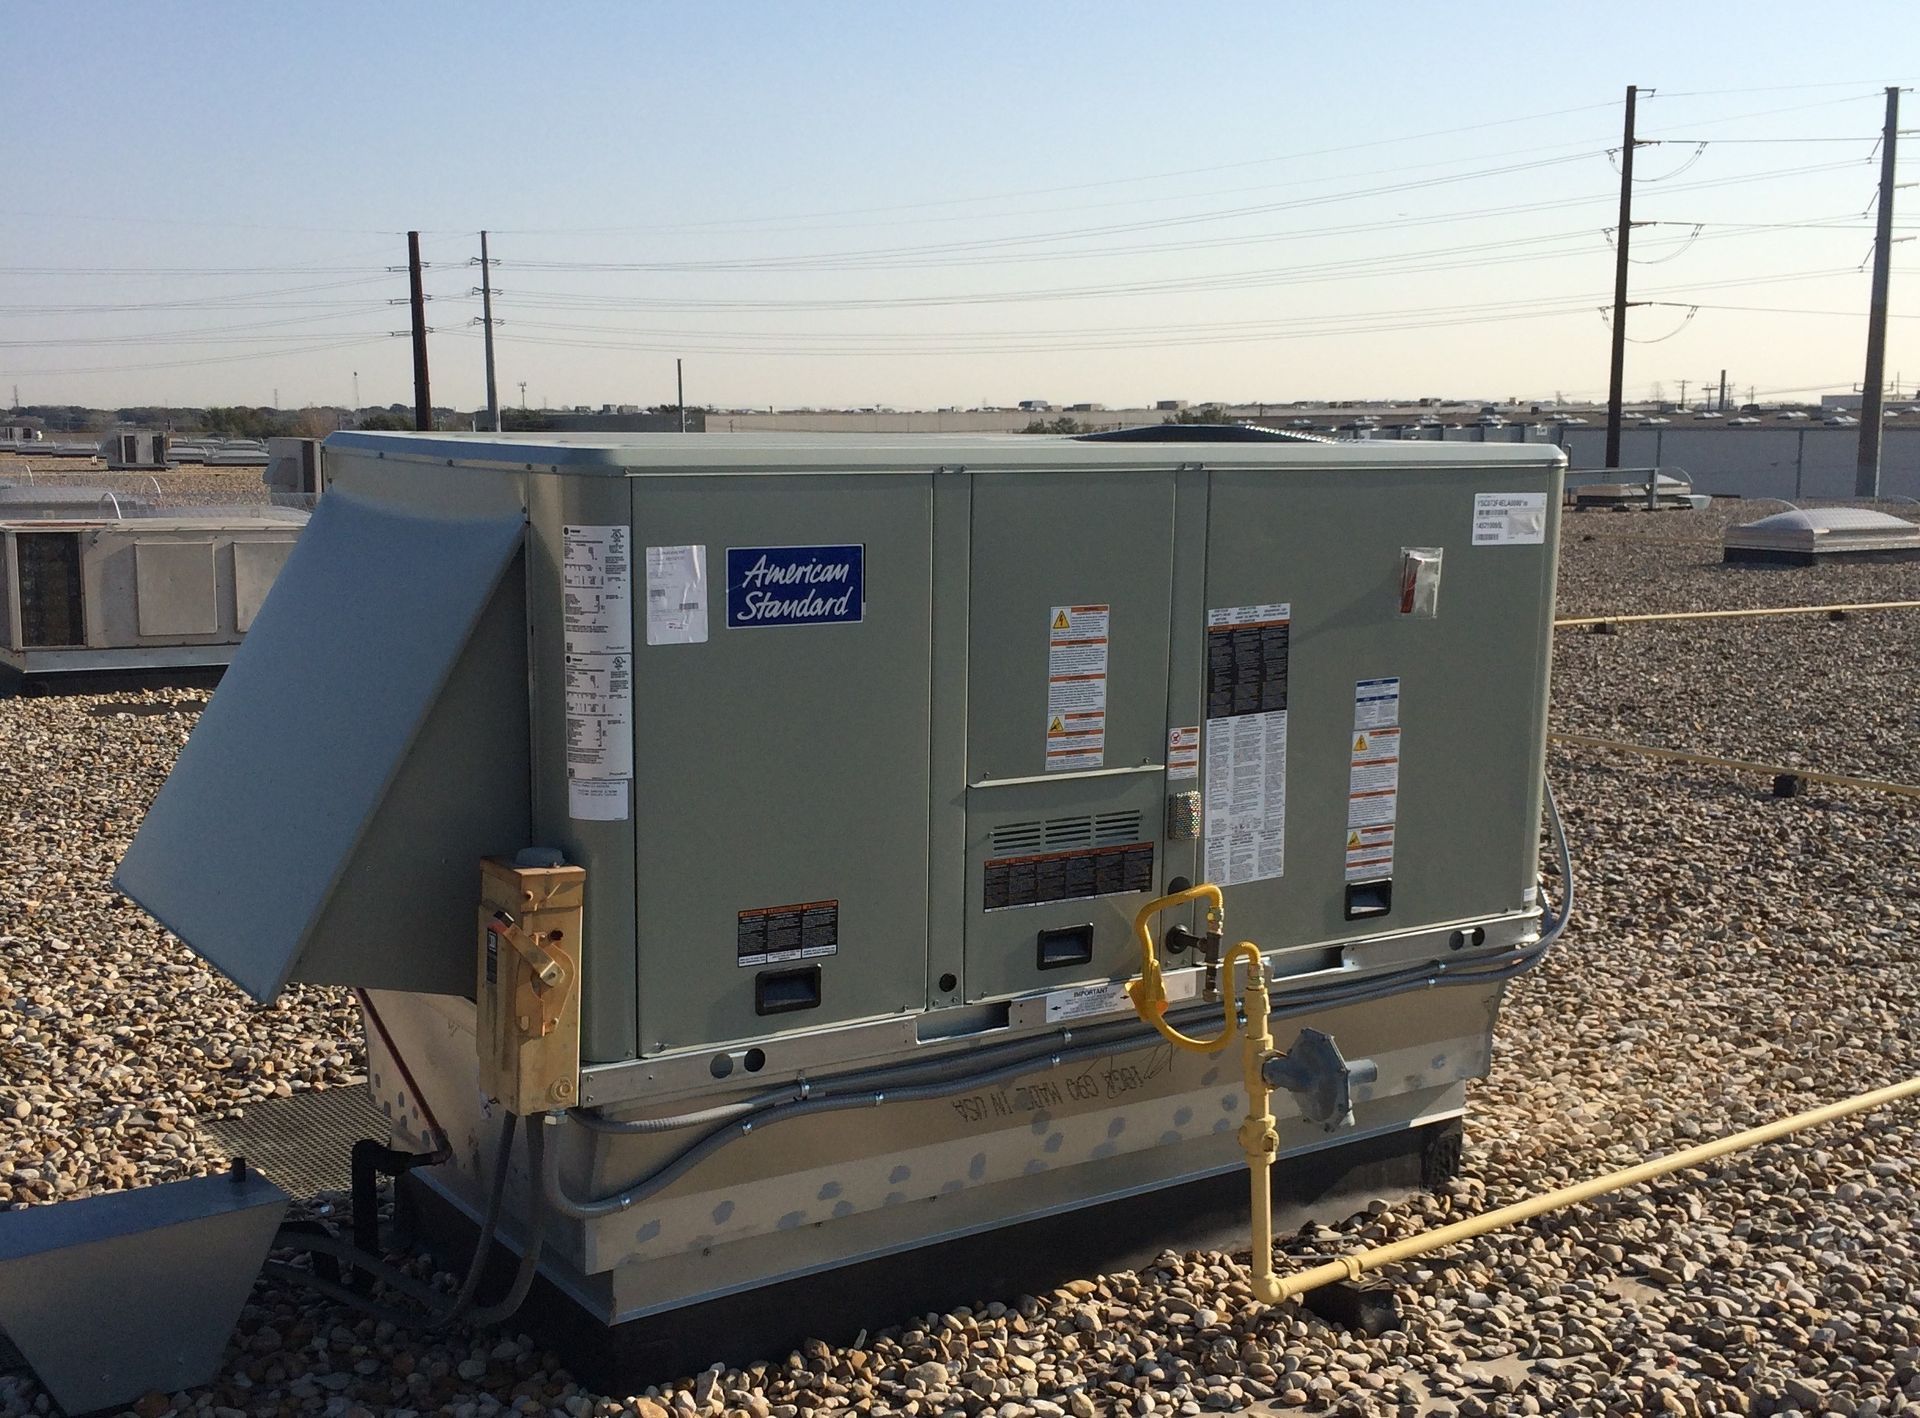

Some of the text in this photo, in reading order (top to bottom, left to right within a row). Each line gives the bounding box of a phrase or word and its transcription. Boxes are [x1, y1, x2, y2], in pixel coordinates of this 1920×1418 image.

[742, 554, 850, 588] American
[737, 586, 854, 620] Standard
[1073, 986, 1109, 998] IMPORTANT
[952, 1095, 988, 1123] USA
[992, 1090, 1014, 1116] IN
